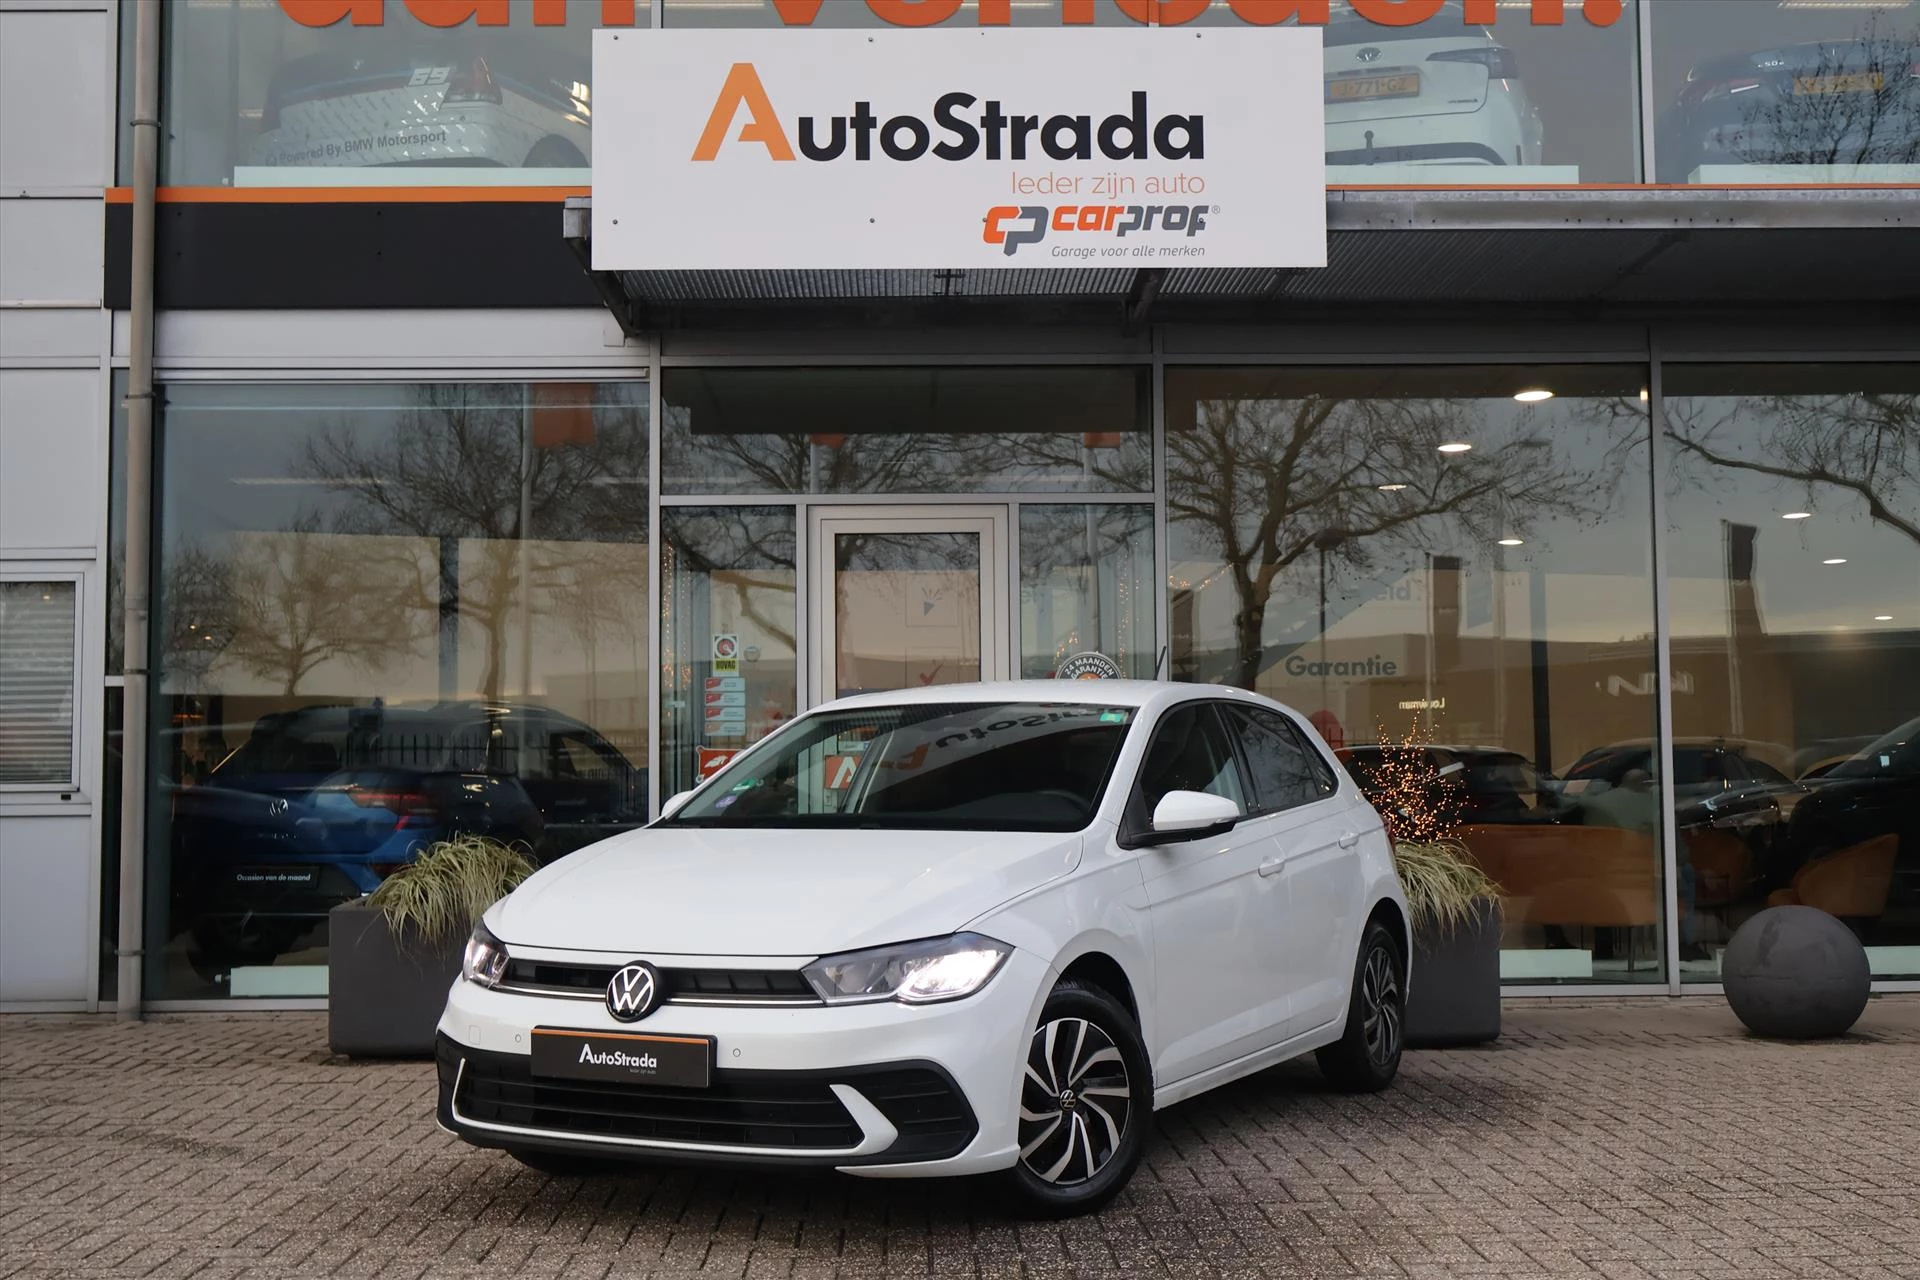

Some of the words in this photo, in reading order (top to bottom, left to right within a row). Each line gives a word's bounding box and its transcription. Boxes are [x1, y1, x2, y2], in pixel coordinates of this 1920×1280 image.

[690, 62, 1205, 162] AutoStrada
[326, 142, 342, 158] By
[344, 137, 374, 153] BMW
[377, 131, 447, 148] Motorsport
[1012, 172, 1083, 194] Ieder
[1092, 172, 1135, 199] zijn
[1145, 173, 1205, 194] auto
[1051, 246, 1097, 260] Garage
[1101, 248, 1129, 257] voor
[1132, 245, 1154, 257] alle
[1158, 245, 1206, 257] merken
[1064, 664, 1075, 675] 24
[1075, 657, 1115, 676] MAANDEN
[1285, 654, 1397, 677] Garantie
[278, 873, 287, 881] de
[578, 1043, 657, 1068] AutoStrada
